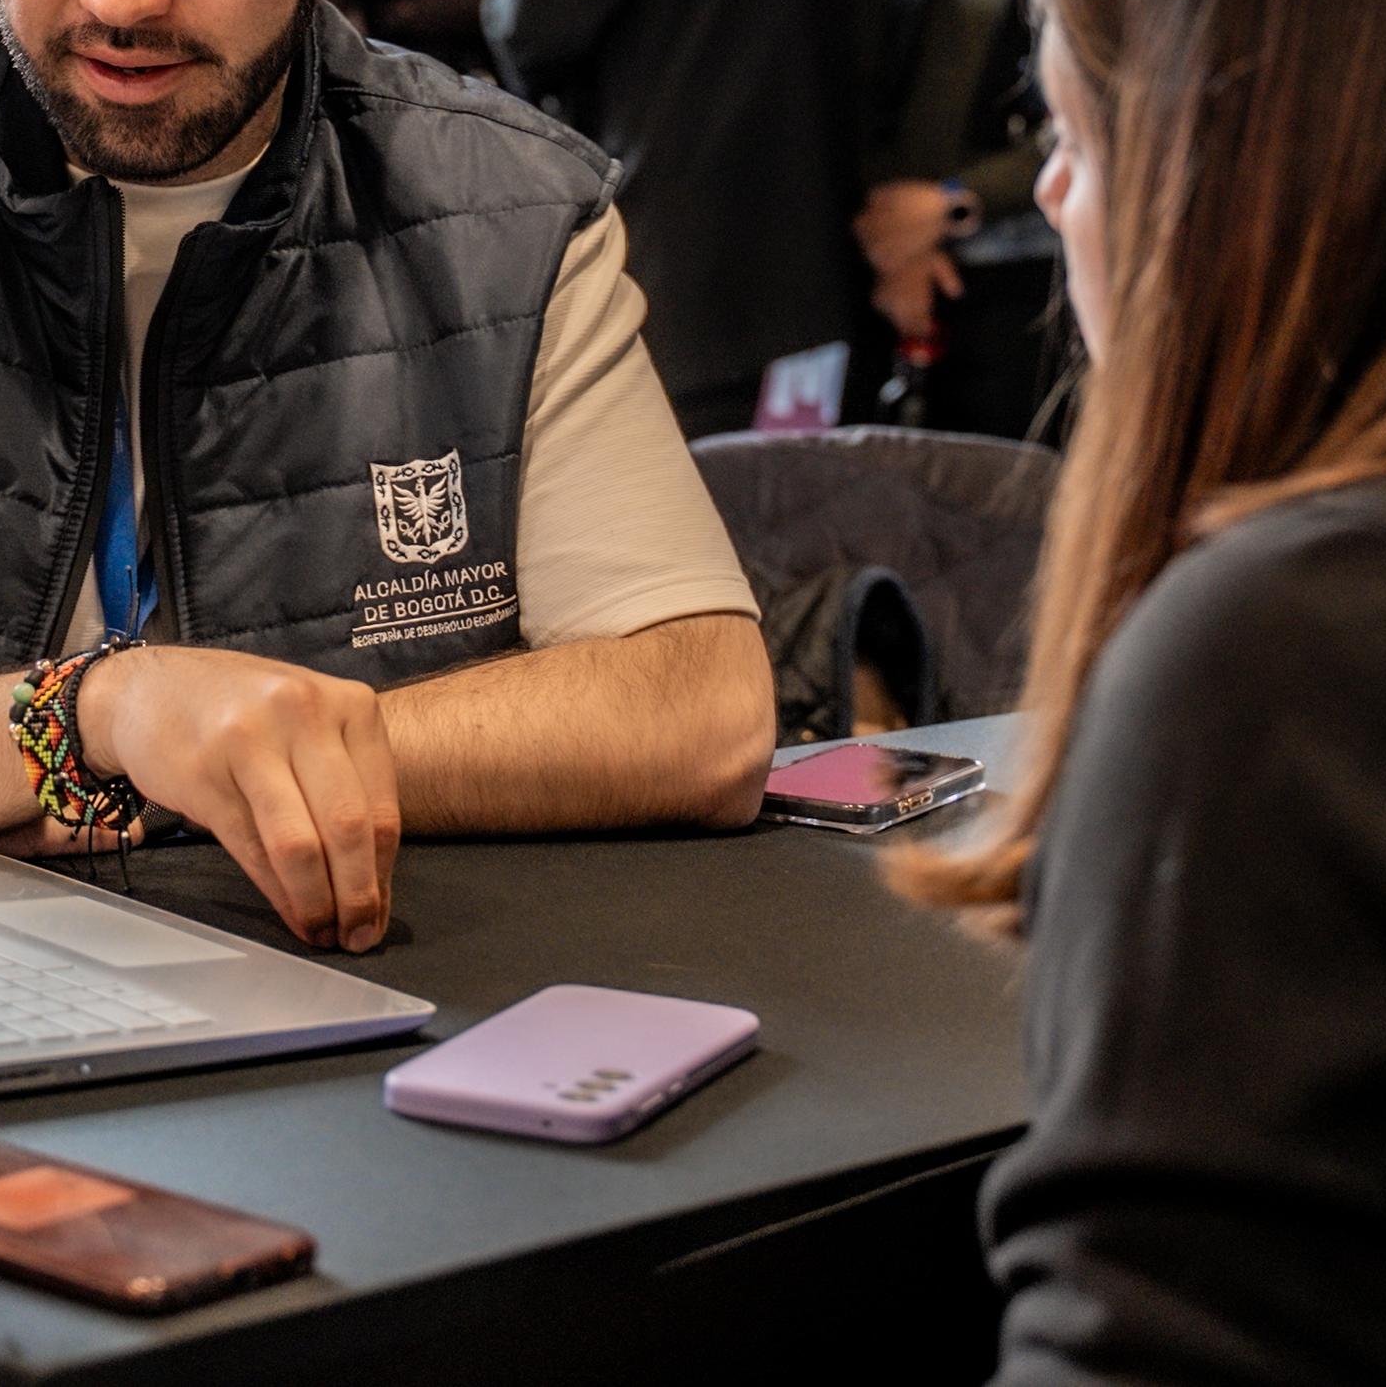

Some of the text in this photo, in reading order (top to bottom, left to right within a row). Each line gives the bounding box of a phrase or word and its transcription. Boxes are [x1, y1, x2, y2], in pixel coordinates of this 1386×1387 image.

[355, 562, 508, 601] ALCALDÍA MAYOR
[364, 586, 504, 623] DE BOGOTÁ D.C.
[404, 627, 416, 639] DE
[417, 618, 473, 637] DESARROLLO
